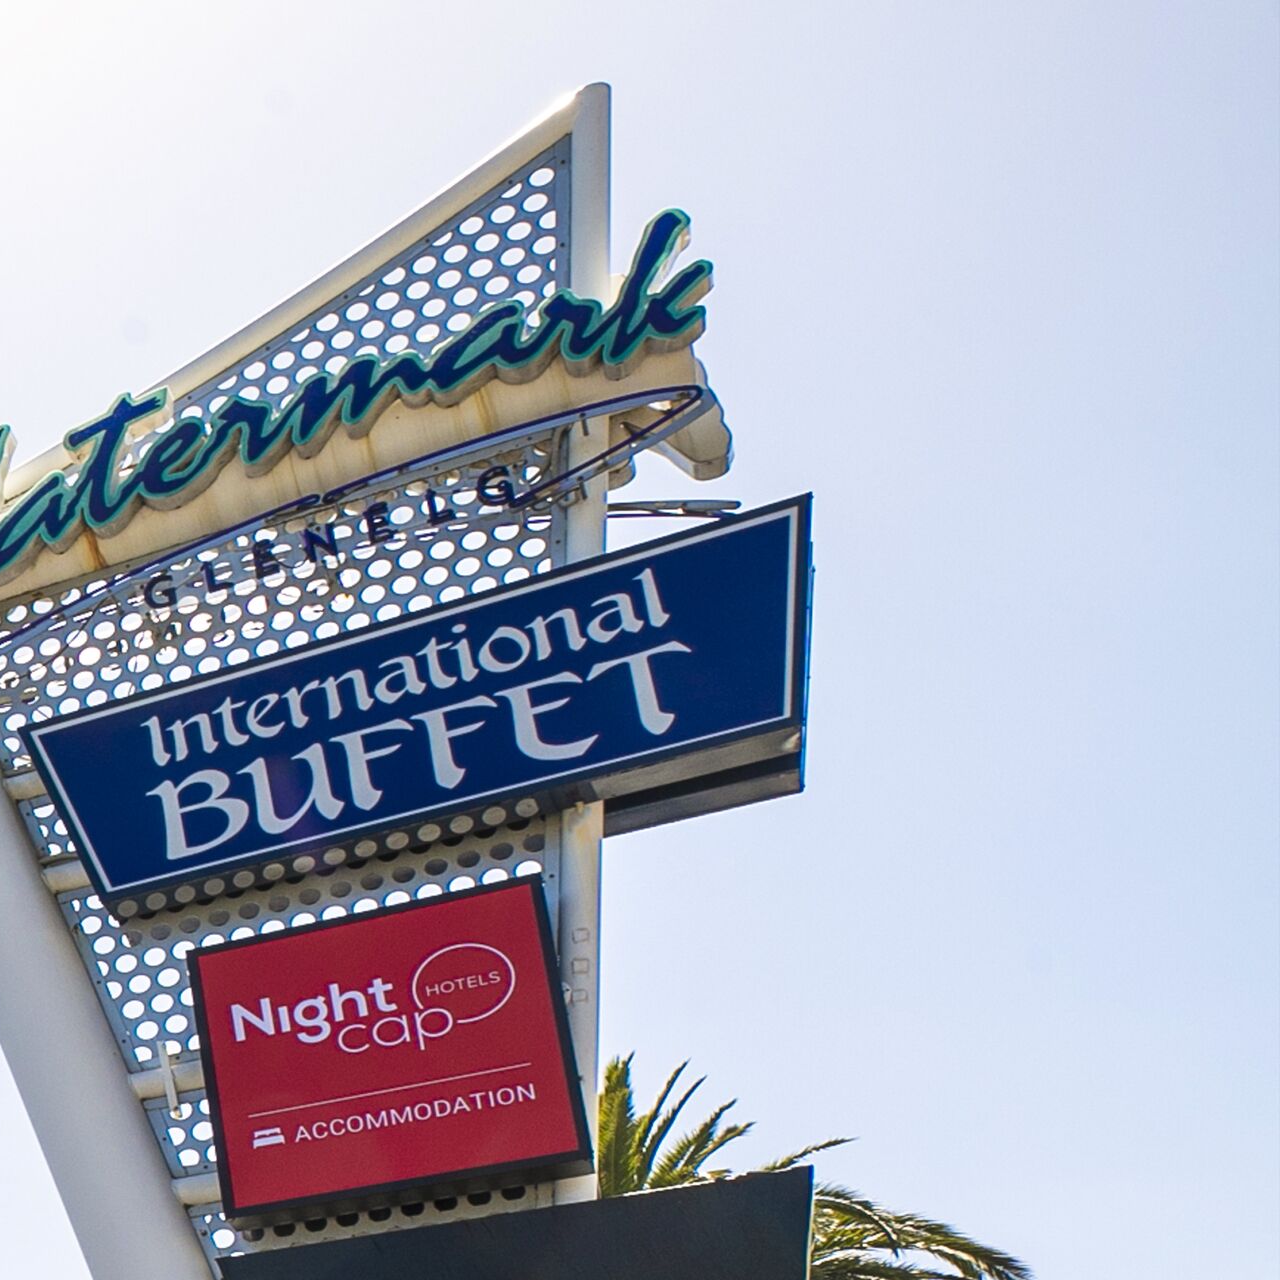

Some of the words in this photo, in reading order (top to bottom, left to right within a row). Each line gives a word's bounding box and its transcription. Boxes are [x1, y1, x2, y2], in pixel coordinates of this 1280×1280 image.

[143, 466, 516, 609] GLENELG
[146, 567, 673, 768] International
[146, 641, 692, 863] BUFFET
[230, 977, 399, 1044] Night
[425, 970, 502, 998] HOTELS
[337, 1007, 454, 1054] cap
[294, 1083, 538, 1143] ACCOMMODATION
